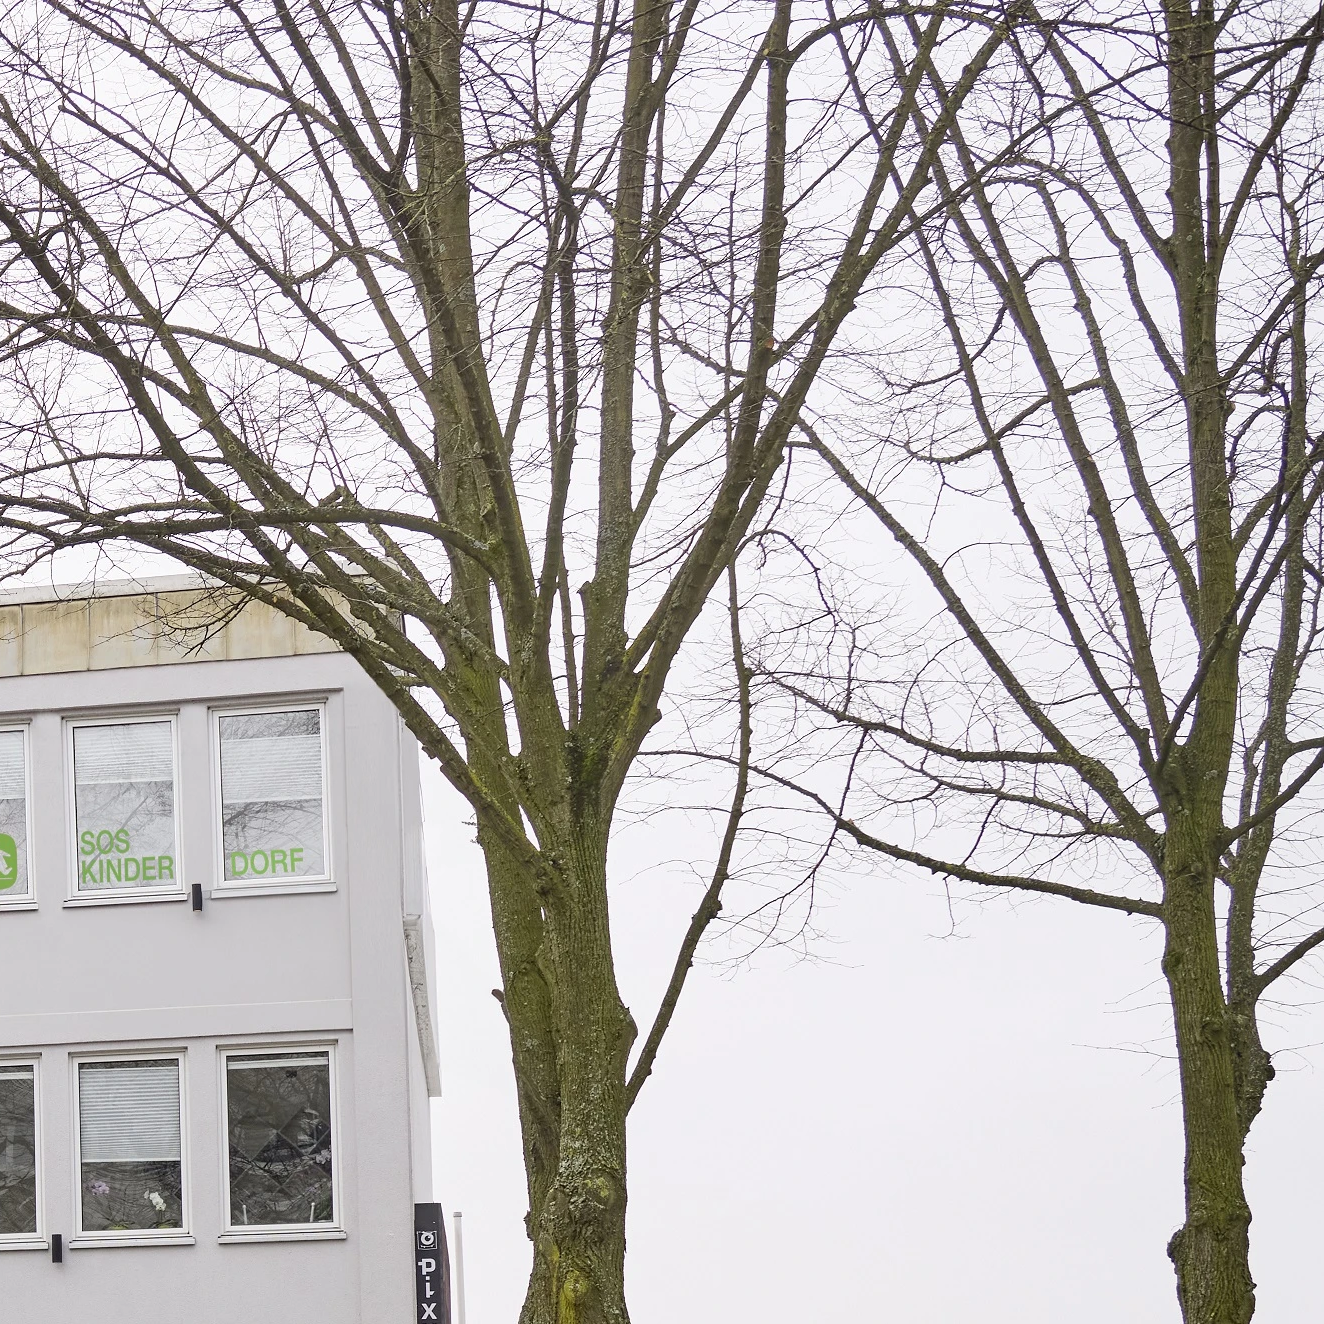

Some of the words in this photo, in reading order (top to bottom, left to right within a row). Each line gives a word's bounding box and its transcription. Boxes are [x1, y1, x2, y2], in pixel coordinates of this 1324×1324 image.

[80, 829, 130, 855] SOS
[81, 855, 175, 884] KINDER
[231, 847, 304, 876] DORF
